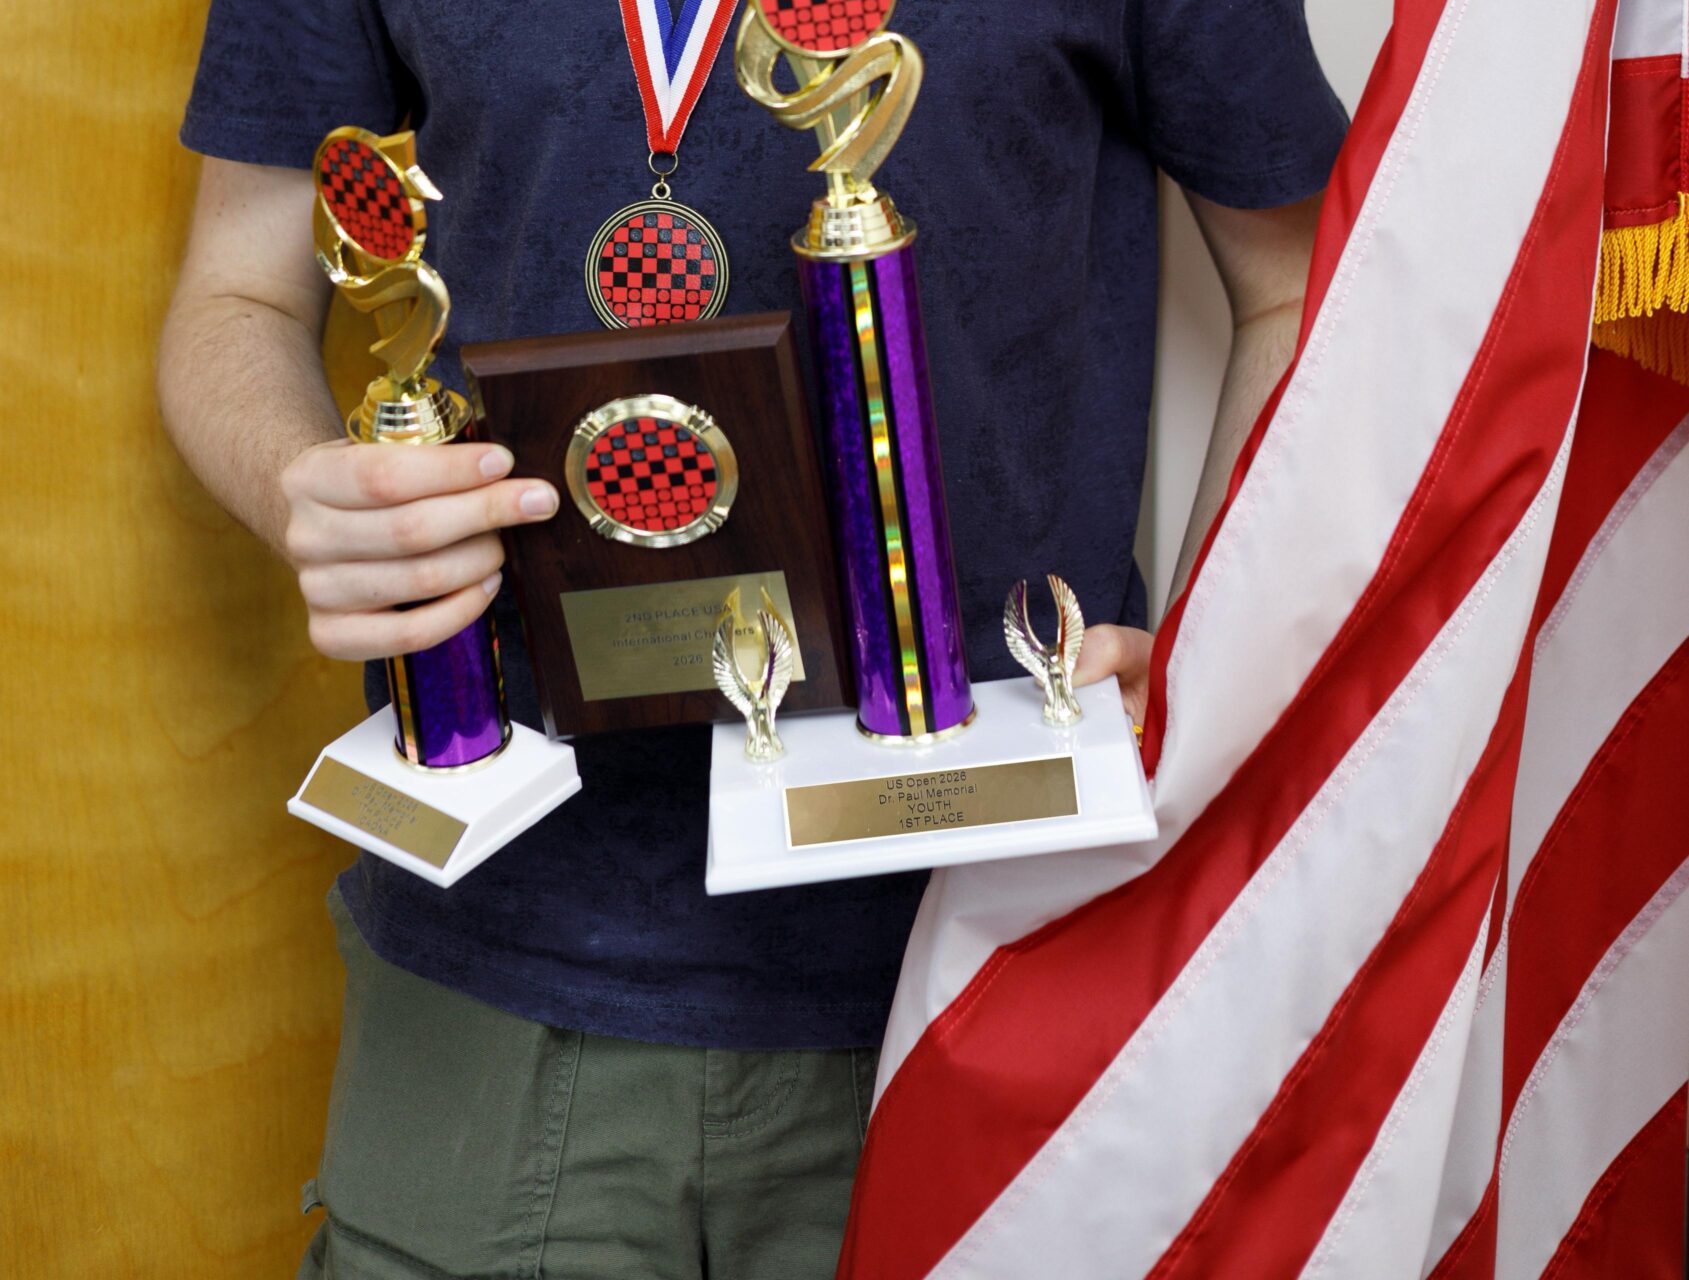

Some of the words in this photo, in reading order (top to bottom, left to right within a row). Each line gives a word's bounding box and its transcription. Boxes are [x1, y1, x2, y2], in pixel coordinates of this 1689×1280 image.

[625, 611, 652, 623] 2ND
[655, 606, 699, 619] PLACE
[703, 603, 732, 615] USA
[612, 631, 691, 648] International
[672, 654, 704, 667] 2026
[886, 779, 903, 790] US
[906, 777, 936, 789] Open
[939, 771, 967, 784] 2026
[878, 794, 895, 805] Dr.
[898, 791, 923, 803] Paul
[926, 784, 978, 799] Memorial
[907, 800, 952, 814] YOUTH
[899, 817, 921, 830] 1ST
[924, 811, 965, 826] PLACE
